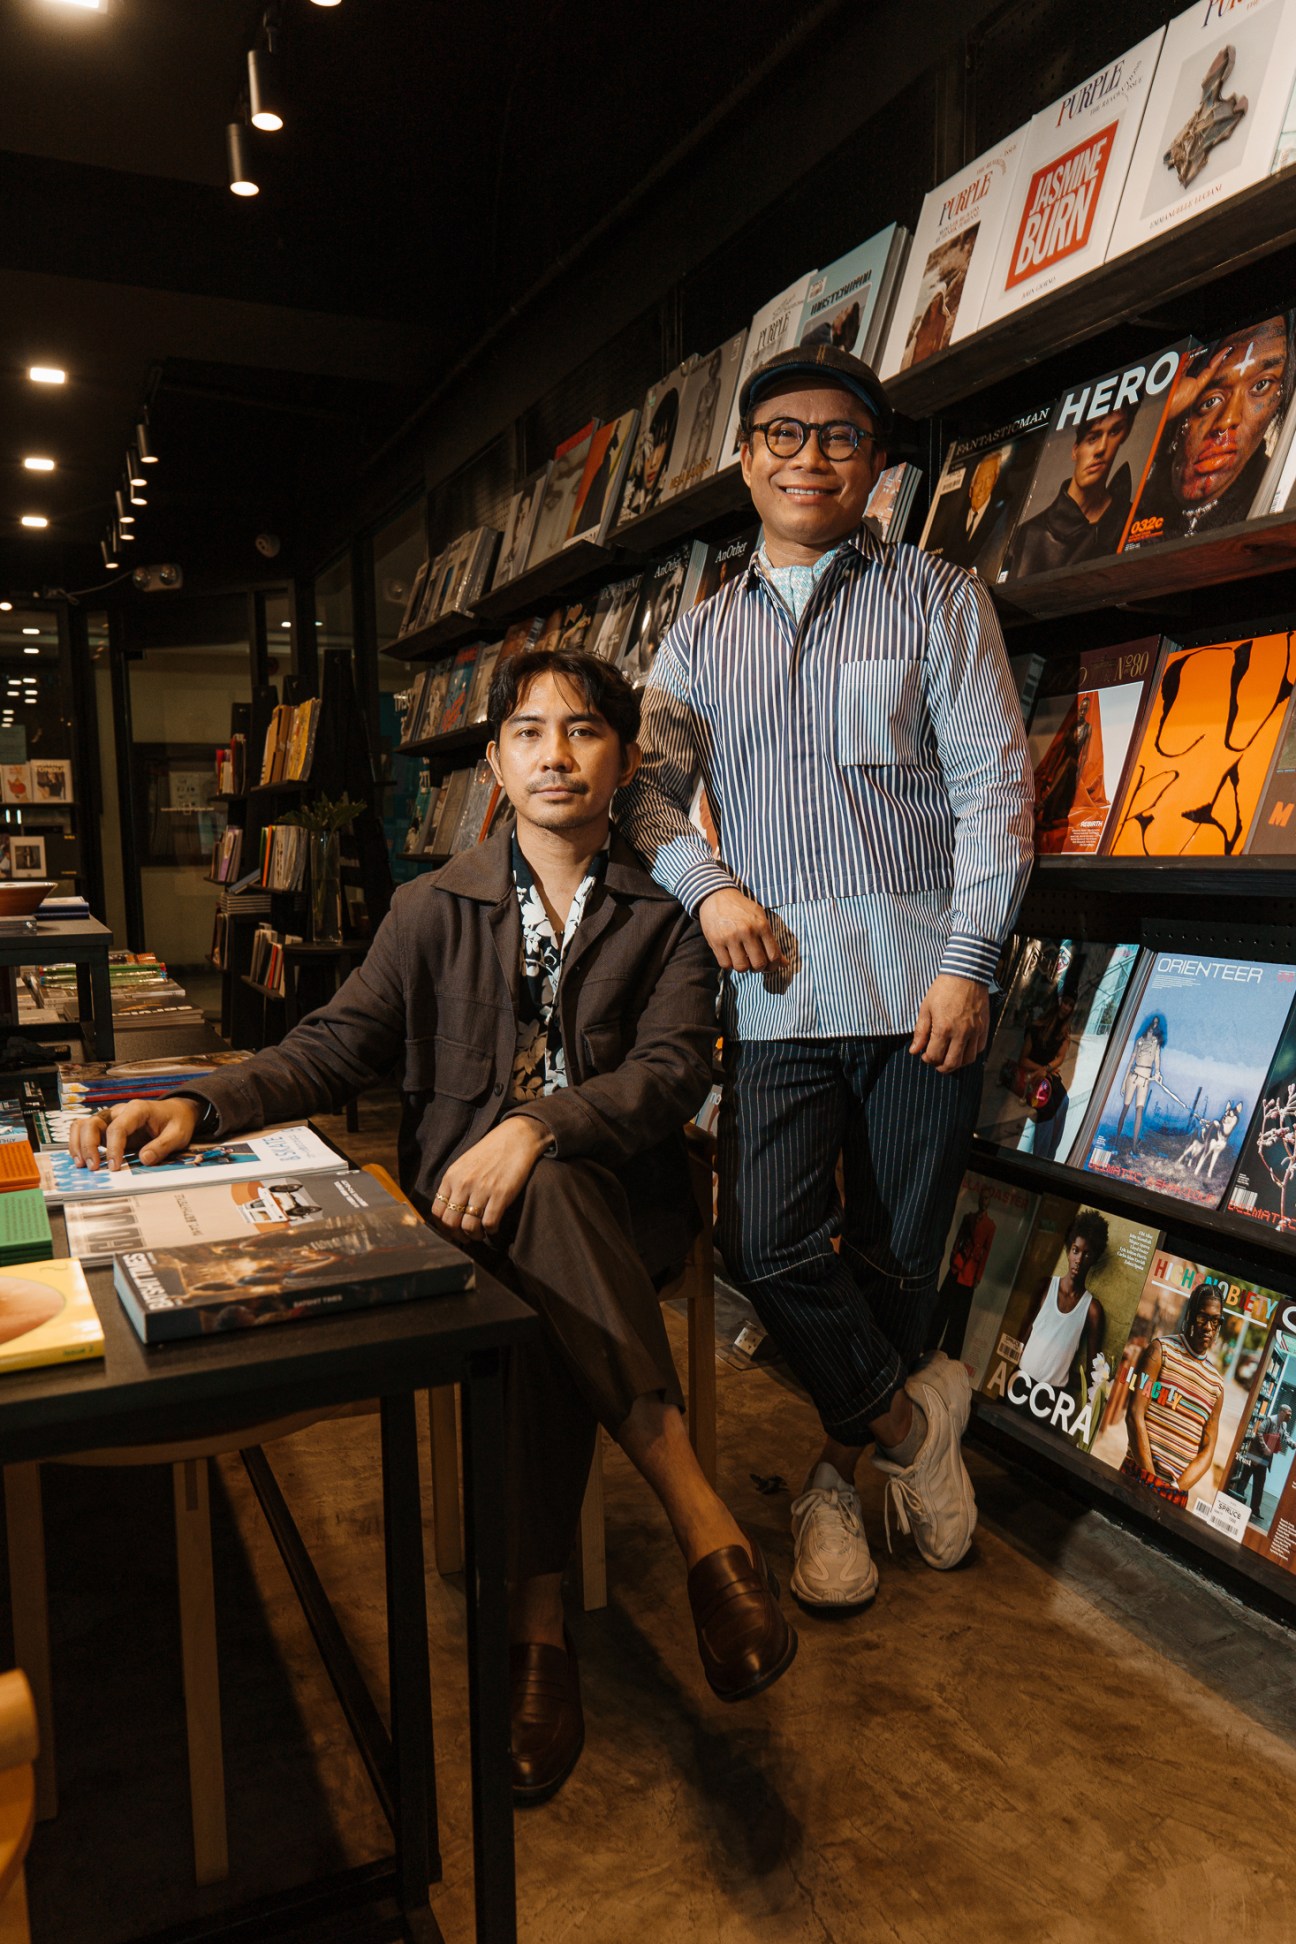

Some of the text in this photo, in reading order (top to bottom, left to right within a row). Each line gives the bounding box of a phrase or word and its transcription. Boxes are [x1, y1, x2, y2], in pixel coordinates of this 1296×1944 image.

[1056, 60, 1125, 128] PURPLE
[938, 170, 993, 227] PURPLE
[1029, 136, 1108, 216] JASMINE
[1014, 180, 1097, 276] BURN
[1056, 351, 1180, 432] HERO
[715, 541, 748, 563] AnOther
[1157, 957, 1264, 984] ORIENTEER
[986, 1361, 1092, 1444] ACCRA
[1139, 1372, 1183, 1411] YACHTY
[1217, 1503, 1242, 1520] SPRUCE
